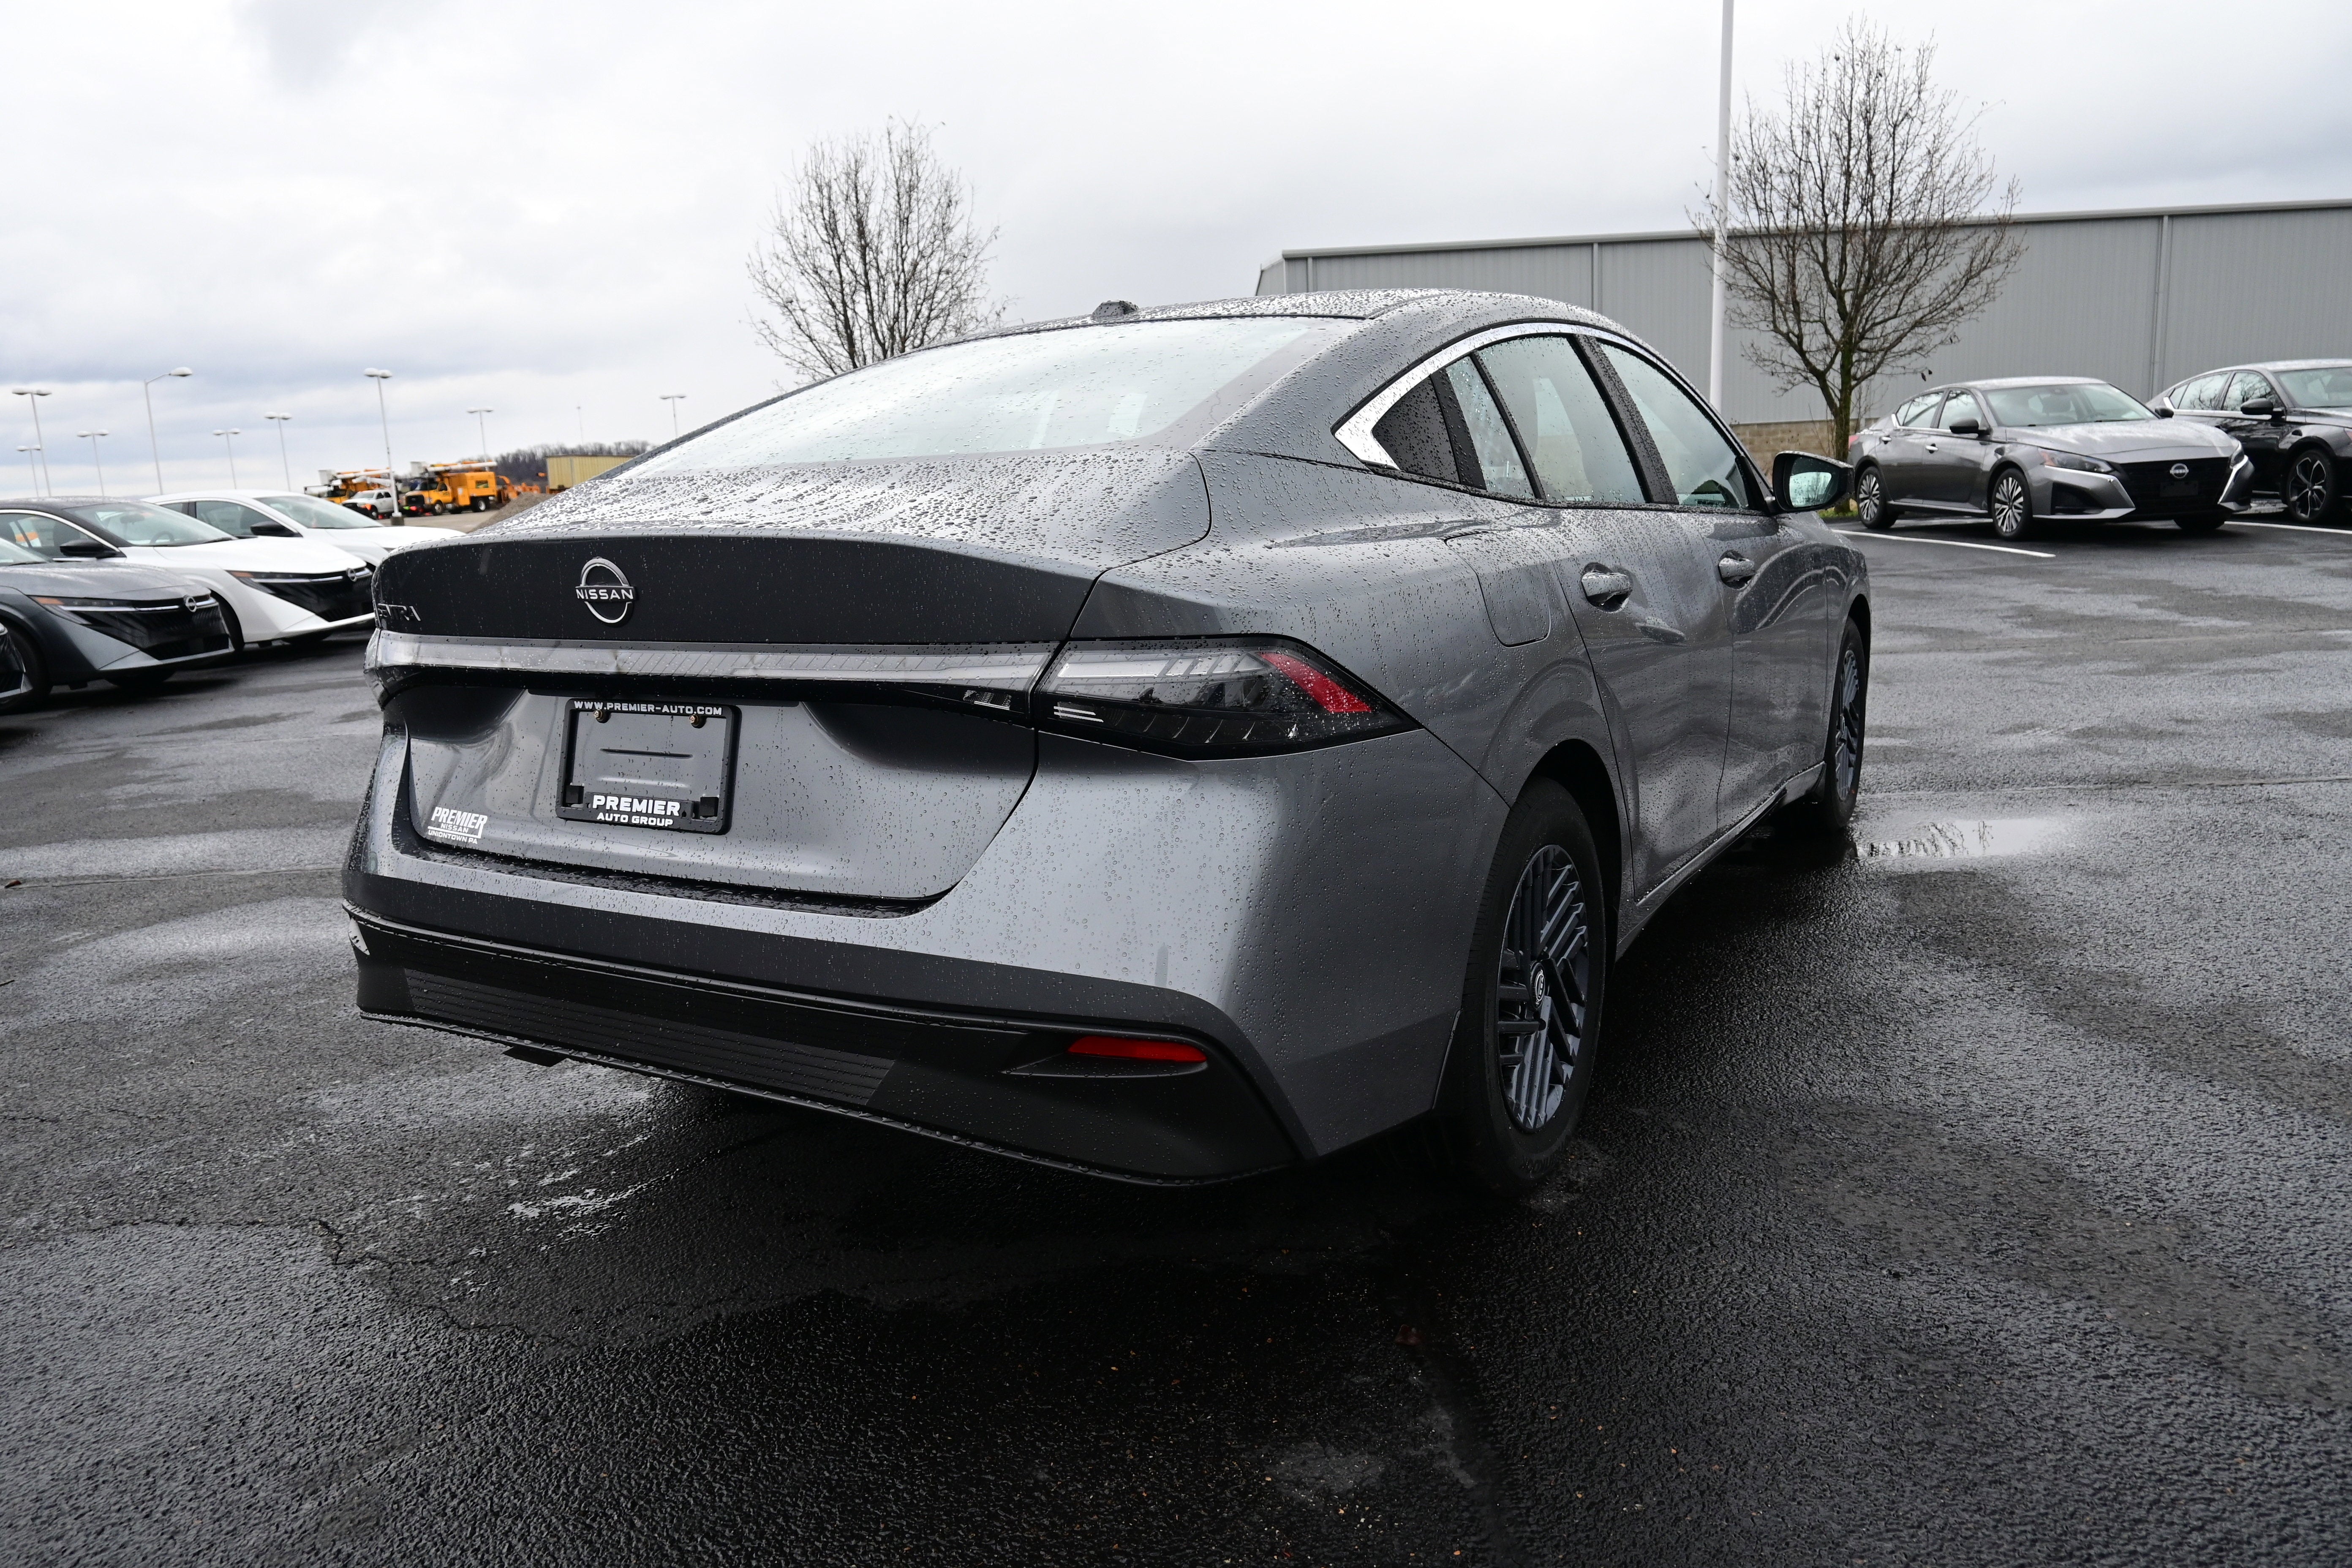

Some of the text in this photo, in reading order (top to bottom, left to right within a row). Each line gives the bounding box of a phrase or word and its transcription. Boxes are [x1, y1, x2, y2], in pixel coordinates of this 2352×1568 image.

[575, 588, 634, 600] NISSAN
[574, 701, 722, 715] WWW.PREMIER-AUTO.COM
[592, 794, 681, 817] PREMIER
[430, 806, 488, 829] PREMIER
[596, 812, 674, 827] AUTO GROUP
[441, 823, 469, 833] NISSAN
[428, 830, 467, 842] UNIONTOWN
